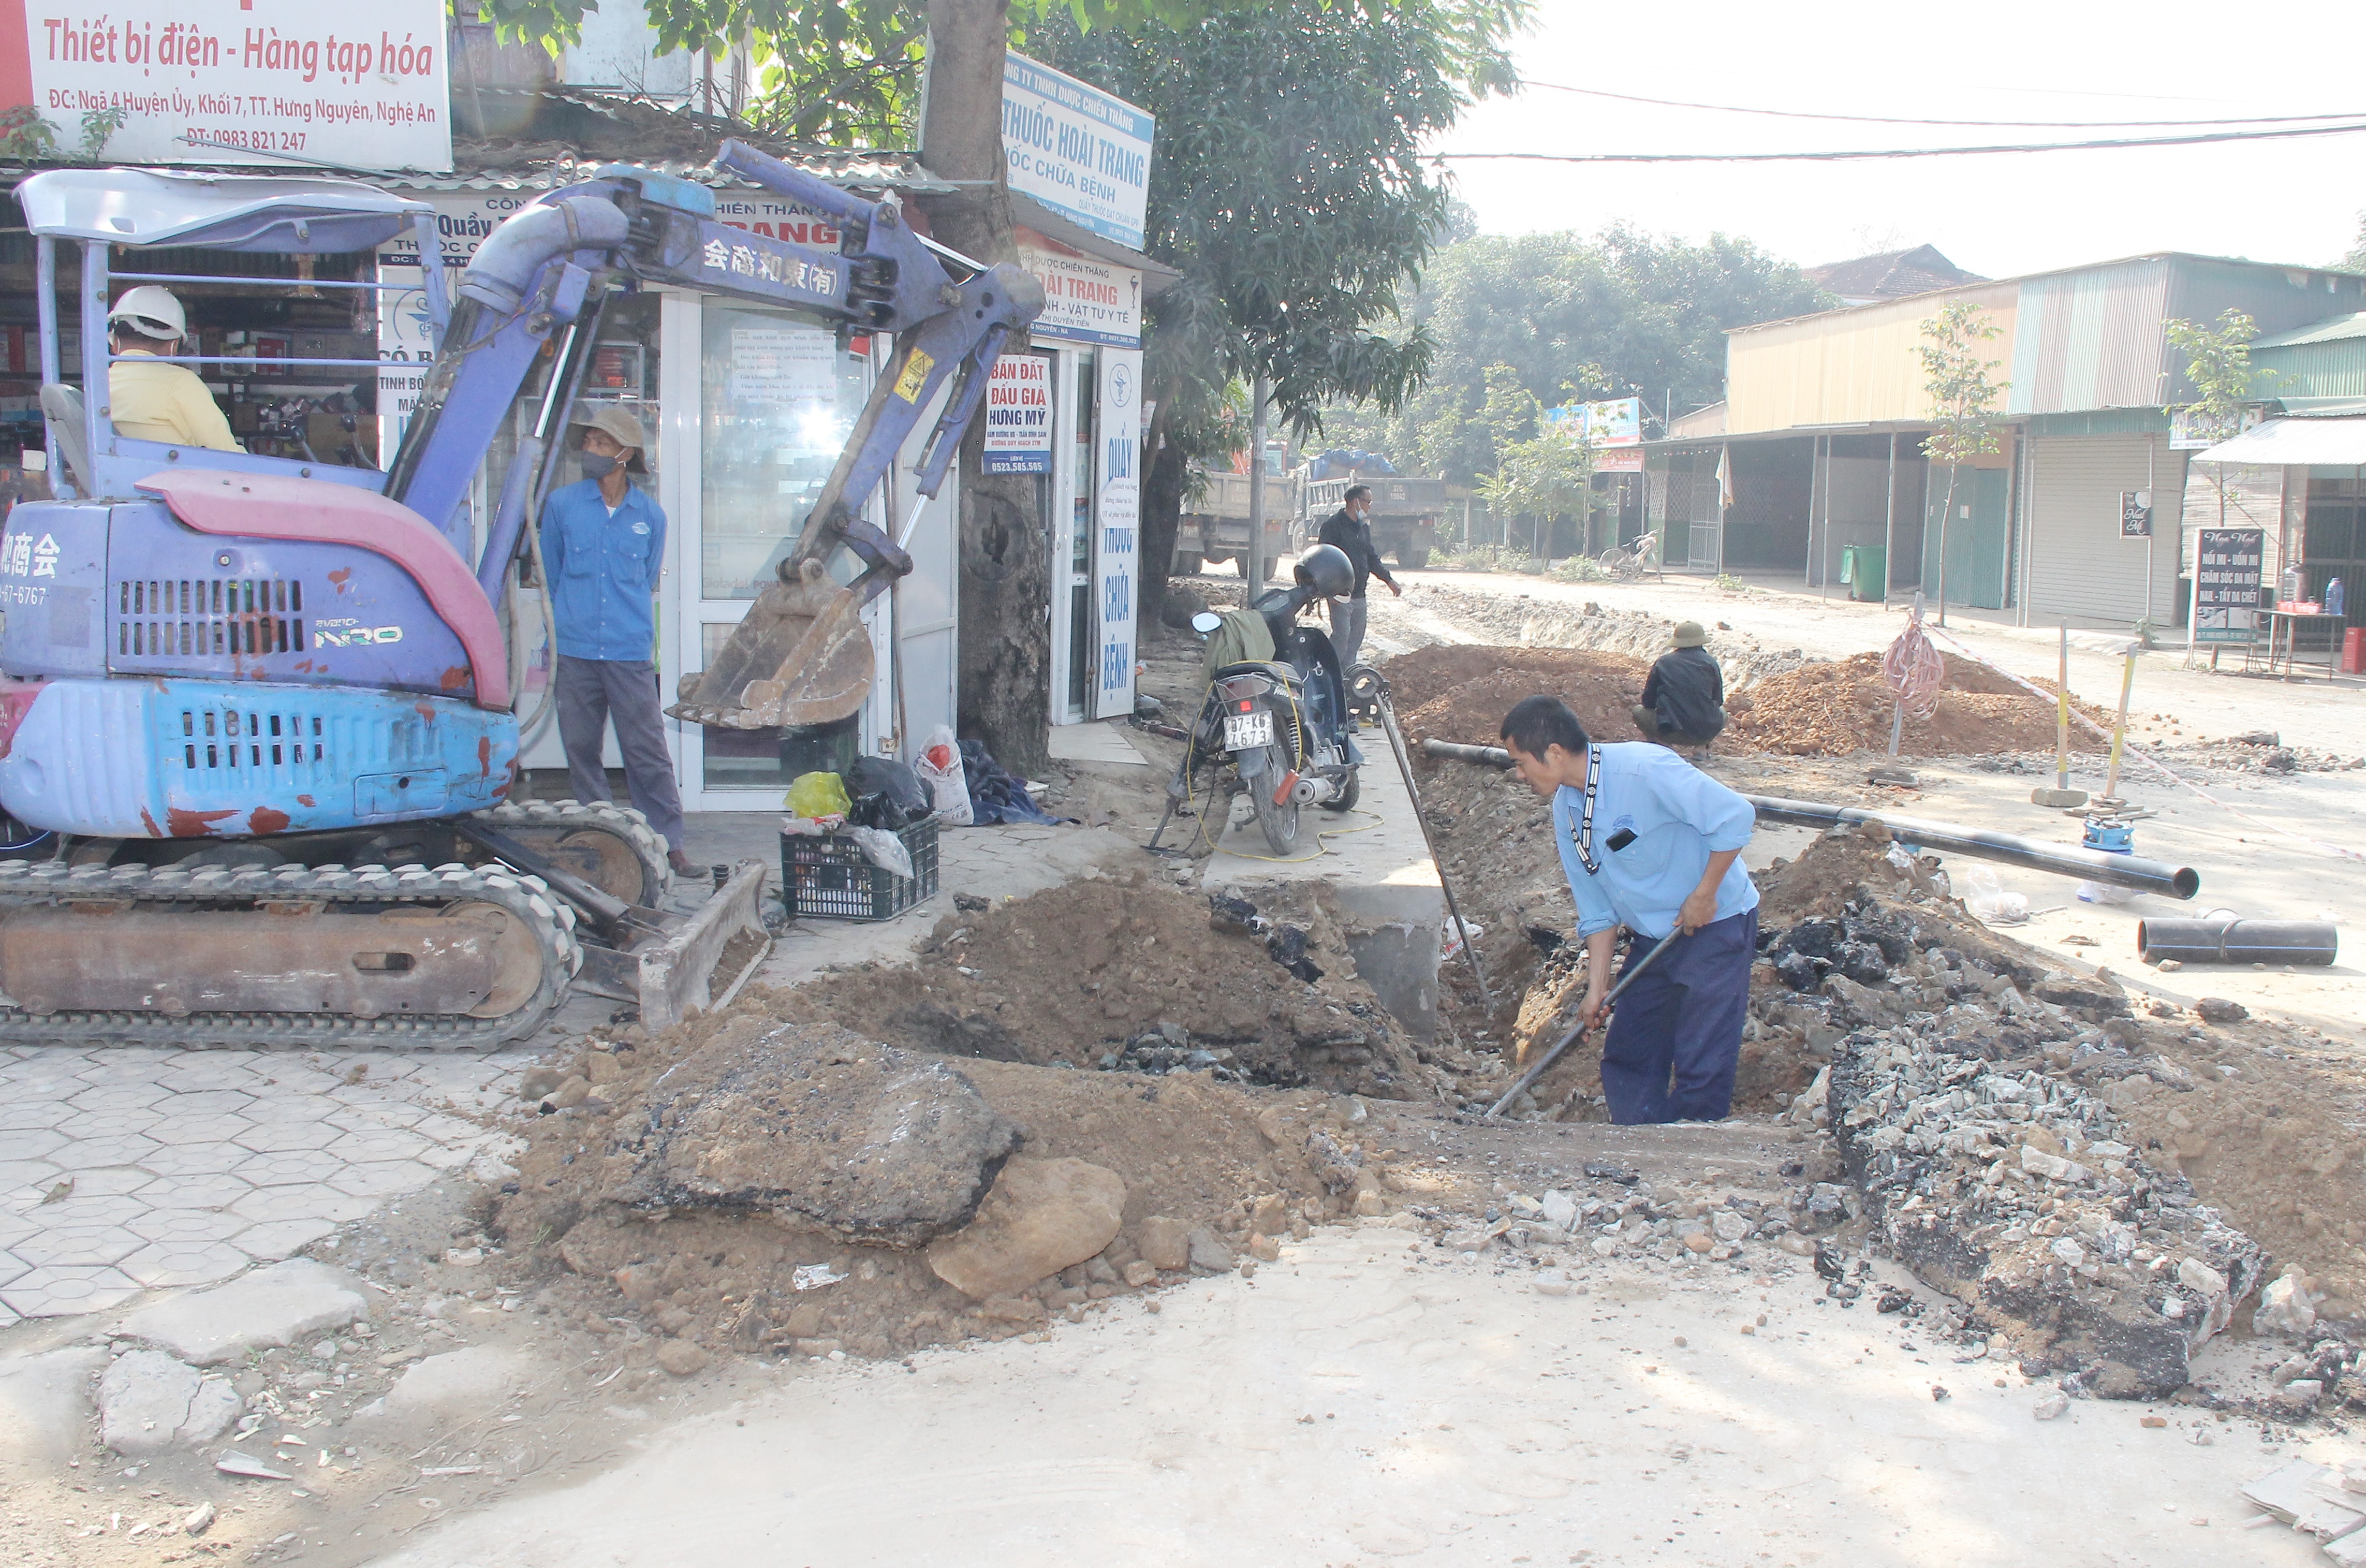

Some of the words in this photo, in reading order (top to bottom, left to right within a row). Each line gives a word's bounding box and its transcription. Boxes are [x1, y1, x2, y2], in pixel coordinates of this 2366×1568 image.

[44, 14, 117, 63] Thiết
[126, 20, 151, 77] bị
[158, 22, 218, 79] điện
[244, 28, 318, 83] Hàng
[327, 35, 372, 84] tạp
[381, 32, 433, 76] hóa
[49, 89, 76, 109] ĐC:
[78, 90, 107, 110] Ngã
[111, 92, 120, 107] 4
[123, 91, 169, 118] Huyện
[173, 87, 195, 119] Ủy,
[199, 92, 231, 114] Khối
[234, 96, 247, 118] 7,
[249, 96, 271, 116] TT.
[273, 97, 312, 123] Hưng
[315, 98, 373, 124] Nguyên,
[377, 100, 414, 127] Nghệ
[417, 102, 436, 123] An
[1022, 68, 1033, 87] TY
[1034, 74, 1057, 98] TNHH
[1059, 85, 1081, 109] DƯỢC
[1082, 96, 1108, 120] CHIẾN
[252, 130, 276, 150] 821
[281, 132, 306, 151] 247
[1002, 97, 1054, 153] THUỐC
[1057, 122, 1095, 169] HOÀI
[1098, 138, 1144, 189] TRANG
[1035, 159, 1076, 189] CHỮA
[1080, 175, 1116, 204] BỆNH
[438, 212, 492, 239] Quầy
[1067, 277, 1118, 306] TRANG
[1068, 302, 1089, 319] VẬT
[1091, 306, 1106, 320] TƯ
[1107, 311, 1115, 321] Y
[1116, 309, 1130, 324] TẾ
[379, 377, 406, 390] TINH
[991, 359, 1017, 380] BÁN
[1020, 358, 1044, 380] ĐẤT
[991, 382, 1018, 405] ĐẤU
[1022, 385, 1047, 406] GIÁ
[989, 408, 1022, 426] HƯNG
[1025, 407, 1046, 426] MỸ
[1108, 422, 1133, 482] QUẦY
[1105, 563, 1129, 623] CHỮA
[1104, 634, 1128, 700] BỆNH
